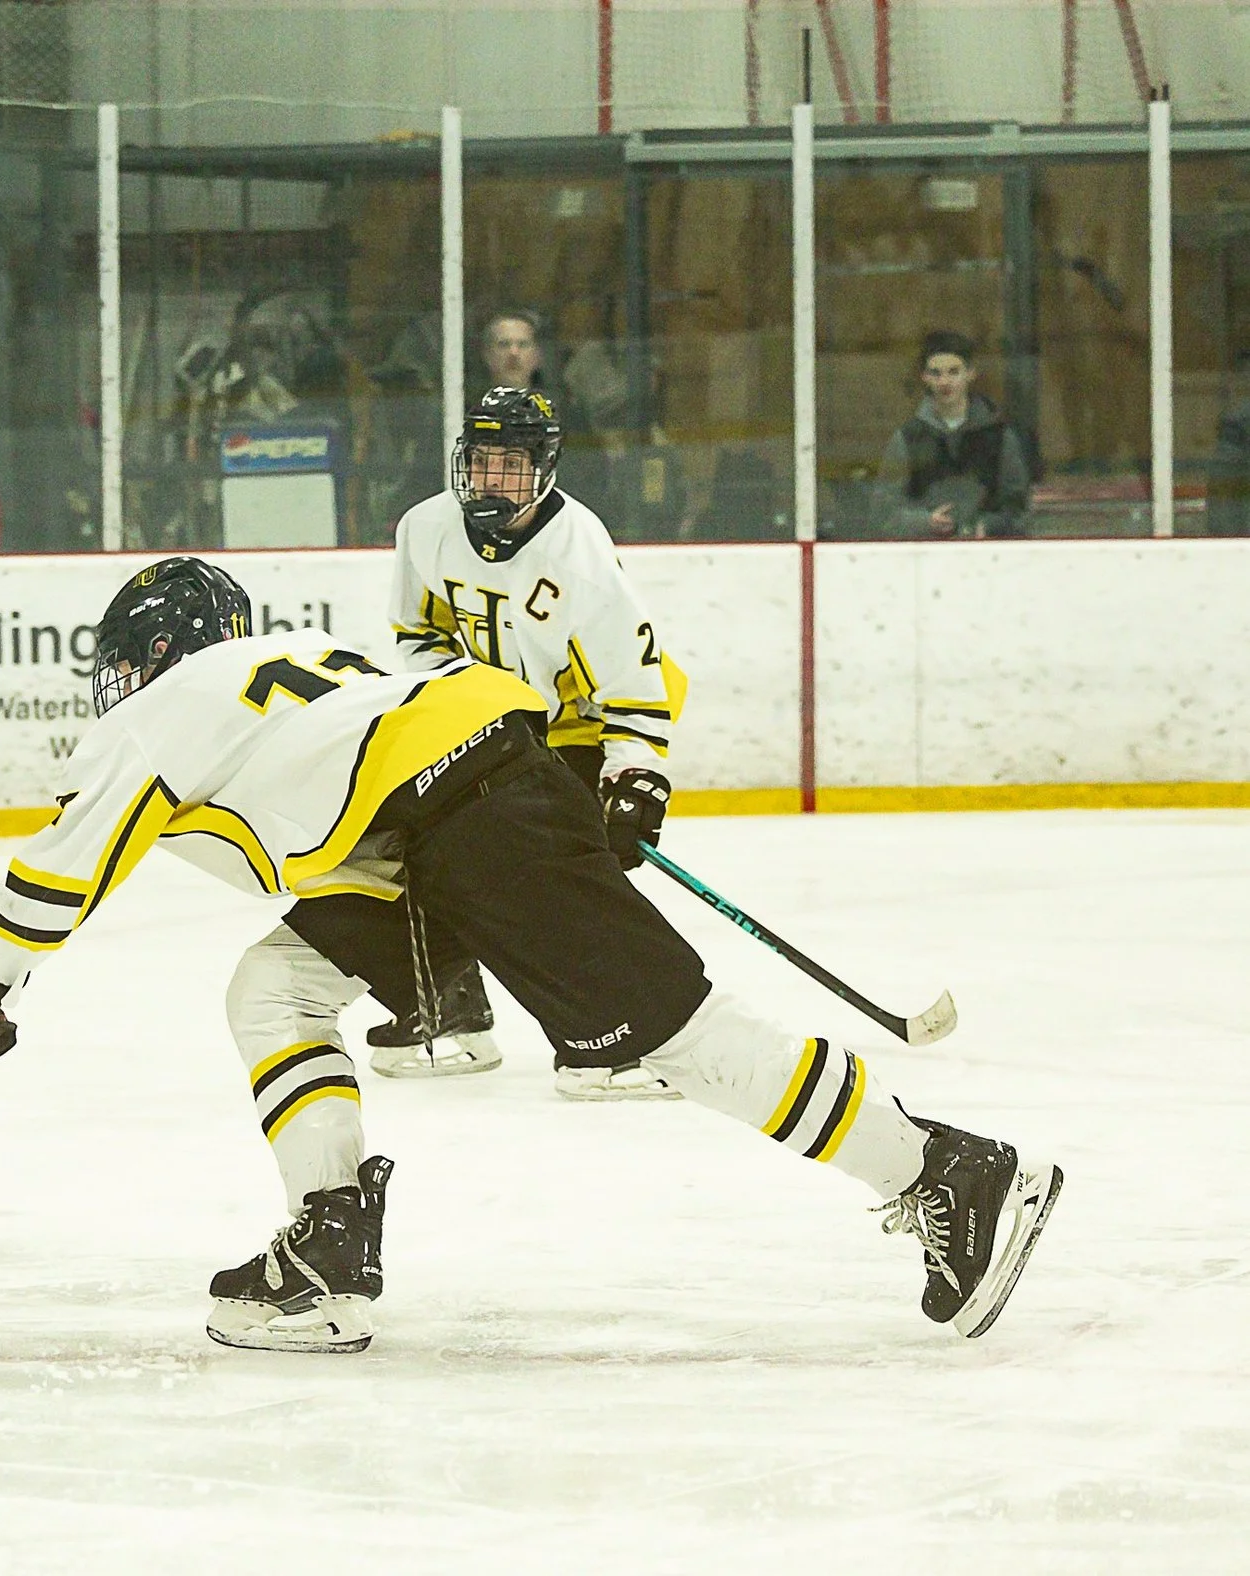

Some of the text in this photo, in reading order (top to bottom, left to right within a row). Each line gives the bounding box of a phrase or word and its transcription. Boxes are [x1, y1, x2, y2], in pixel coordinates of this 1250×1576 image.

[525, 577, 560, 622] C
[636, 621, 662, 666] 2
[966, 1207, 978, 1257] BAUER
